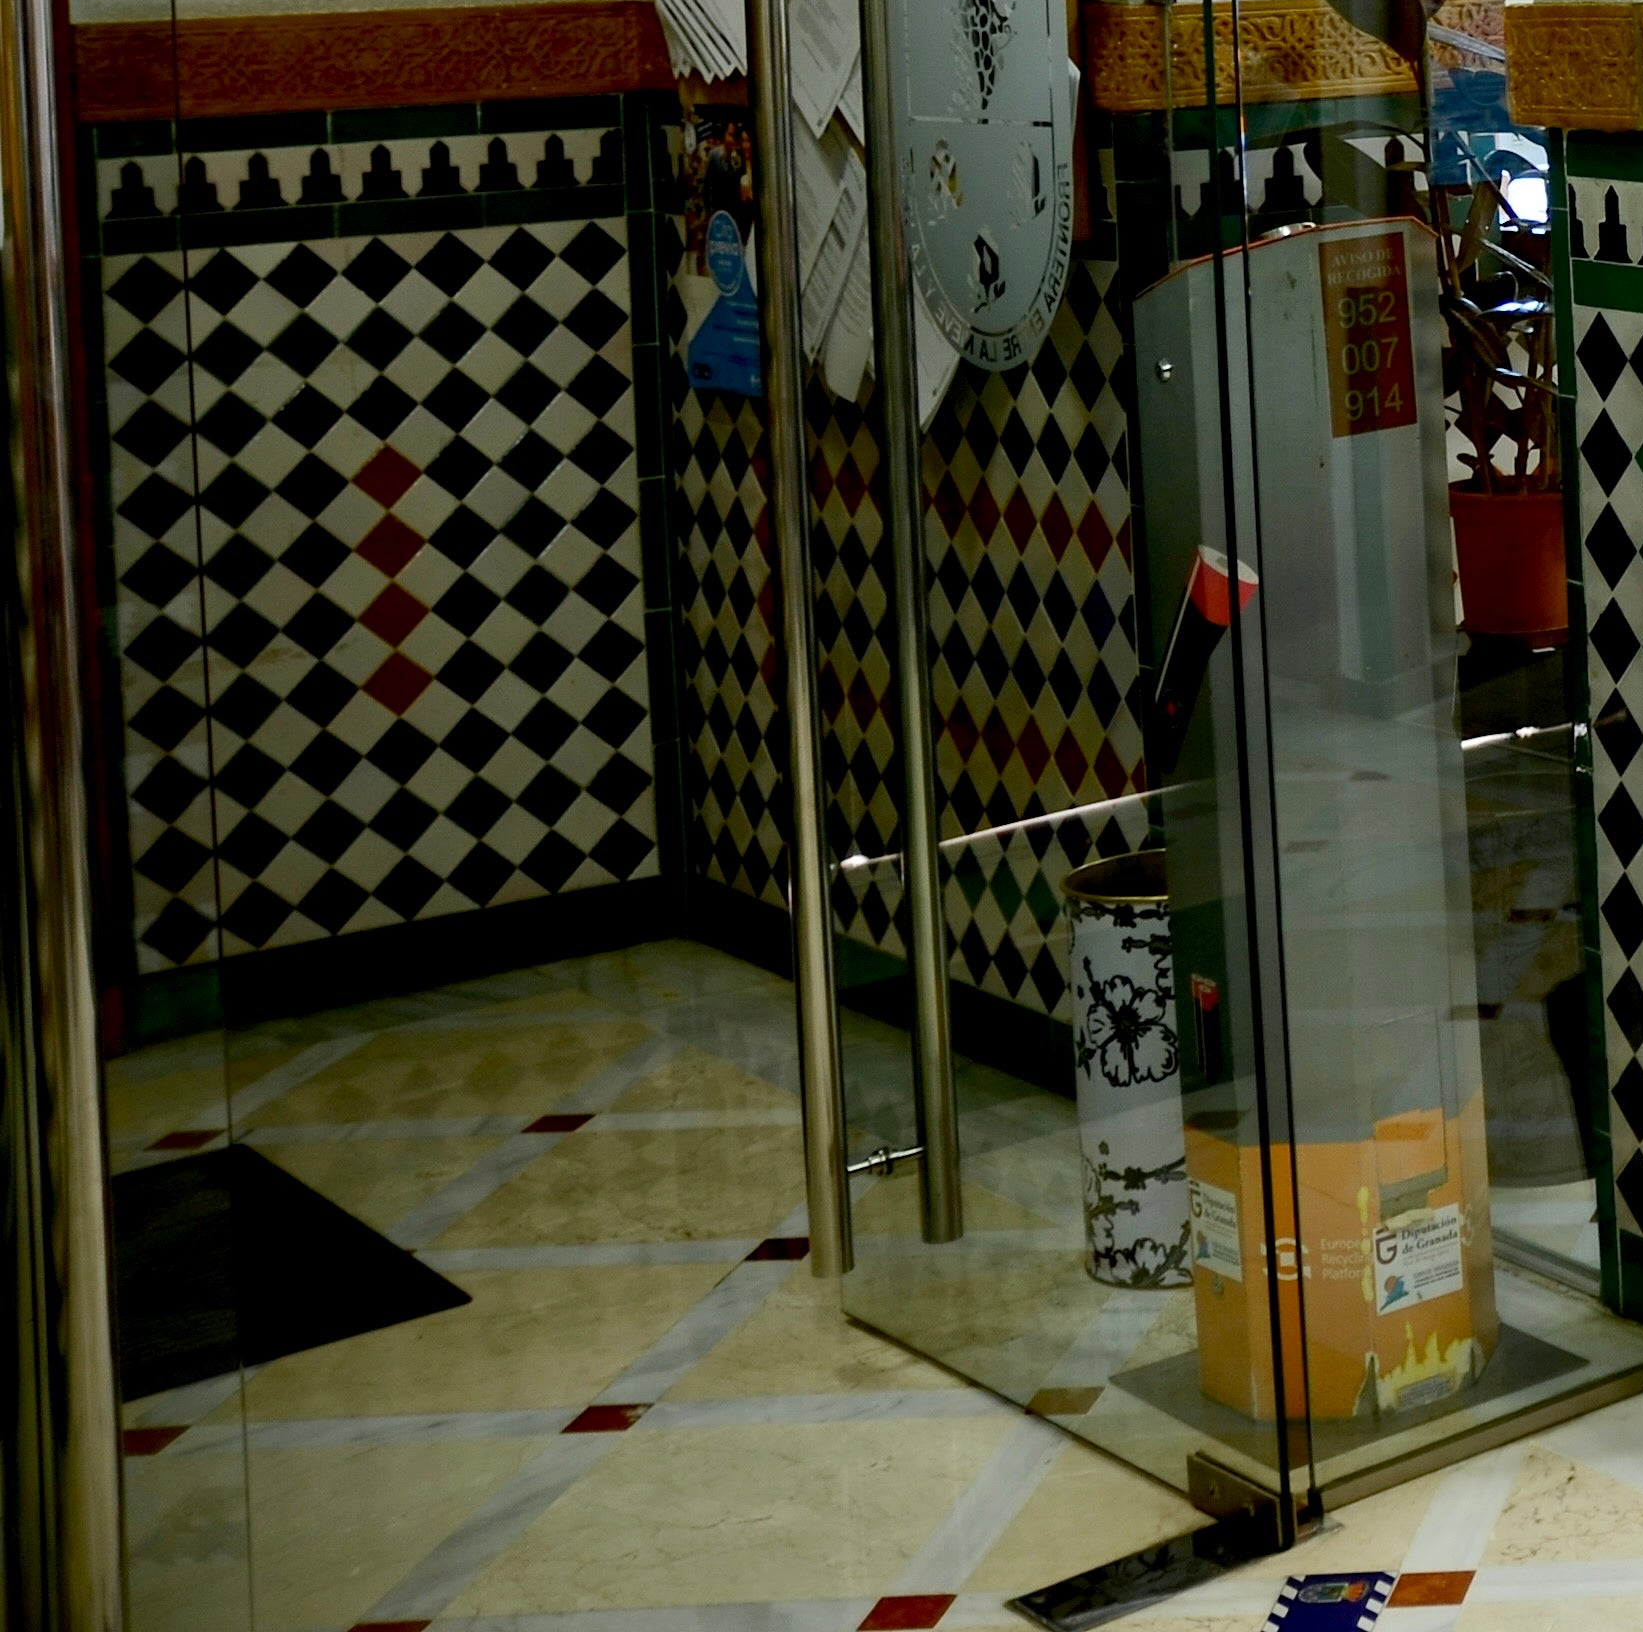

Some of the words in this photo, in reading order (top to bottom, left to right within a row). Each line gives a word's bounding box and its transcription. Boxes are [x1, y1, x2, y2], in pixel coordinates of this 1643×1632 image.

[1333, 250, 1375, 266] AVISO
[1377, 246, 1394, 260] DE
[1327, 266, 1401, 285] RECOGIDA
[1338, 290, 1397, 329] 952
[1341, 336, 1399, 375] 007
[1344, 382, 1404, 421] 914
[1401, 1216, 1457, 1240] Diputación
[1402, 1242, 1414, 1255] de
[1416, 1229, 1458, 1249] Granada
[1322, 1268, 1362, 1280] Platfor
